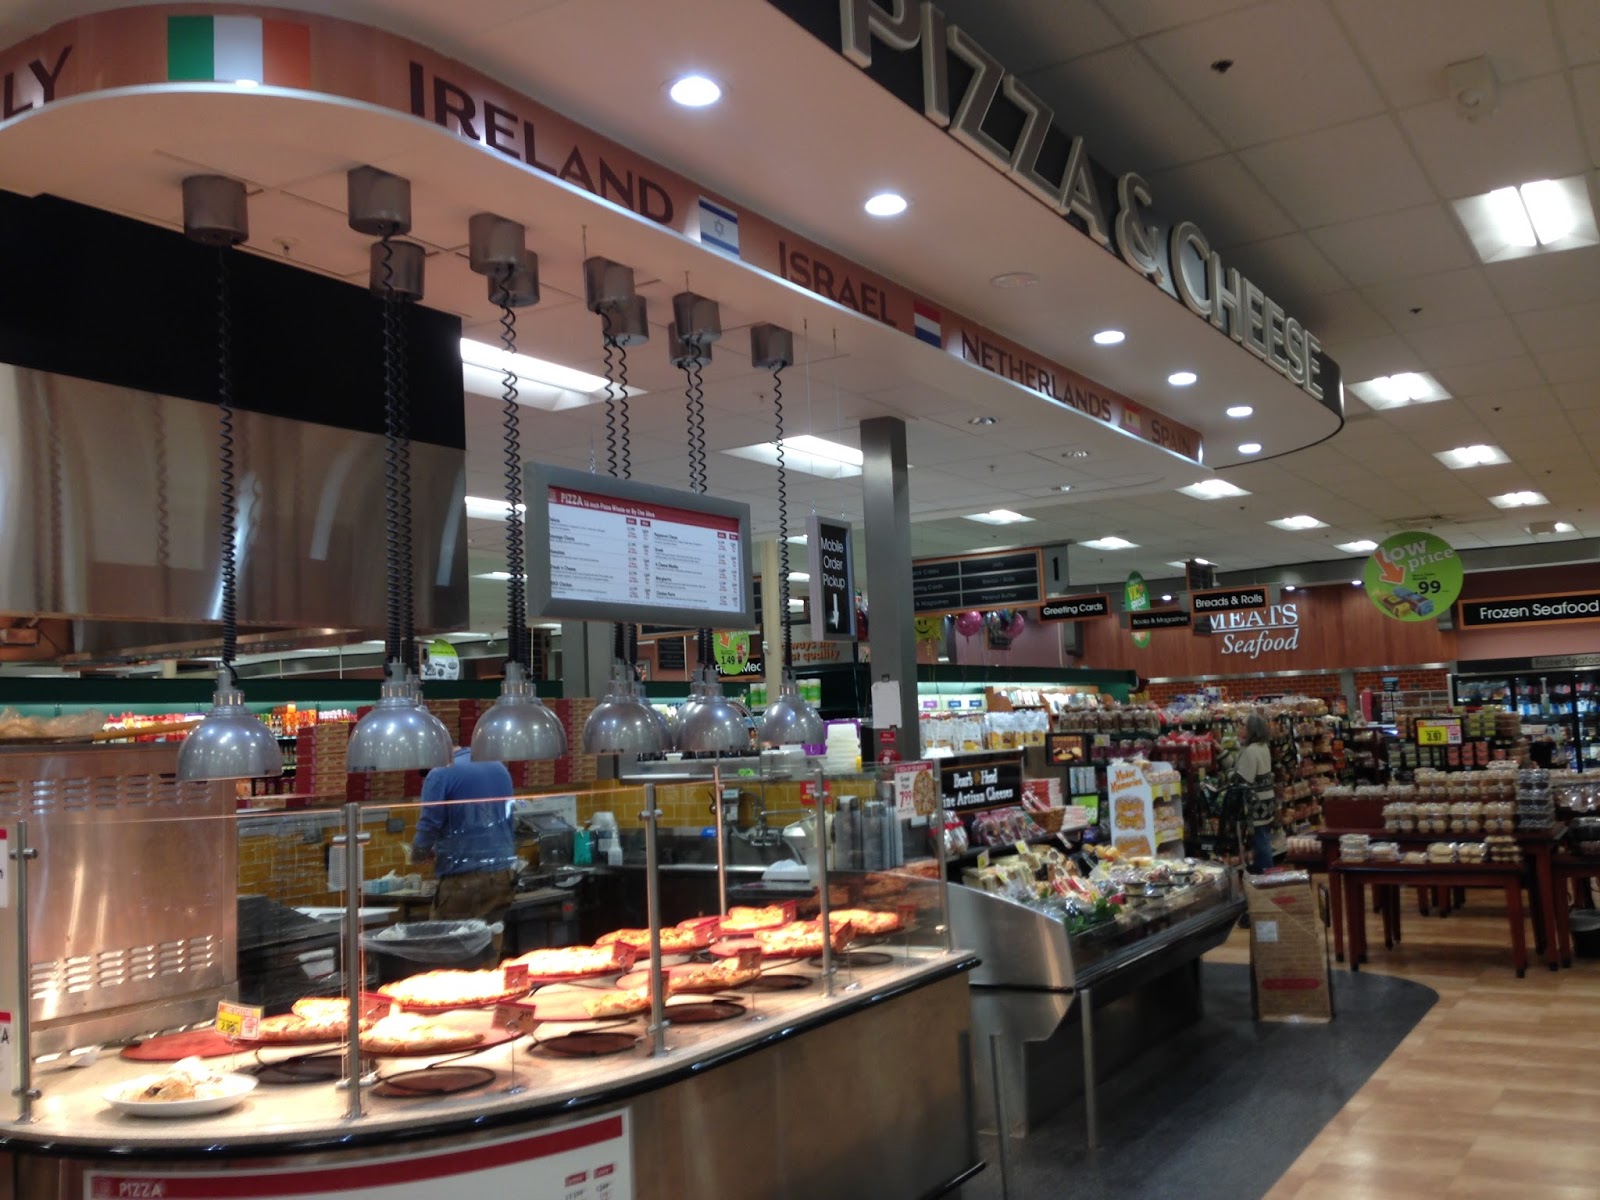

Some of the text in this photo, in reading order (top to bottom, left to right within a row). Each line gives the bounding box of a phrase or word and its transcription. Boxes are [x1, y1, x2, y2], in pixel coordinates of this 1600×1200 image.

[409, 60, 675, 226] IRELAND
[841, 0, 1325, 400] PIZZA & CHEESE
[779, 241, 897, 326] ISRAEL
[962, 329, 1112, 423] NETHERLANDS
[1151, 419, 1192, 456] SPAIN
[560, 492, 583, 507] PIZZA
[820, 537, 844, 554] Mobile
[1377, 540, 1428, 563] low
[823, 555, 843, 571] Order
[1408, 549, 1454, 572] price
[823, 573, 846, 591] Pickup
[1042, 602, 1103, 618] Greeting Cards
[1195, 593, 1263, 608] Breads & Rolls
[1480, 599, 1600, 620] Frozen Seafood
[1209, 603, 1299, 630] MEATS
[1221, 628, 1299, 660] Seafood
[980, 767, 998, 786] Head
[942, 785, 1014, 808] ine Artisan Cheeses
[118, 1182, 163, 1199] PIZZA
